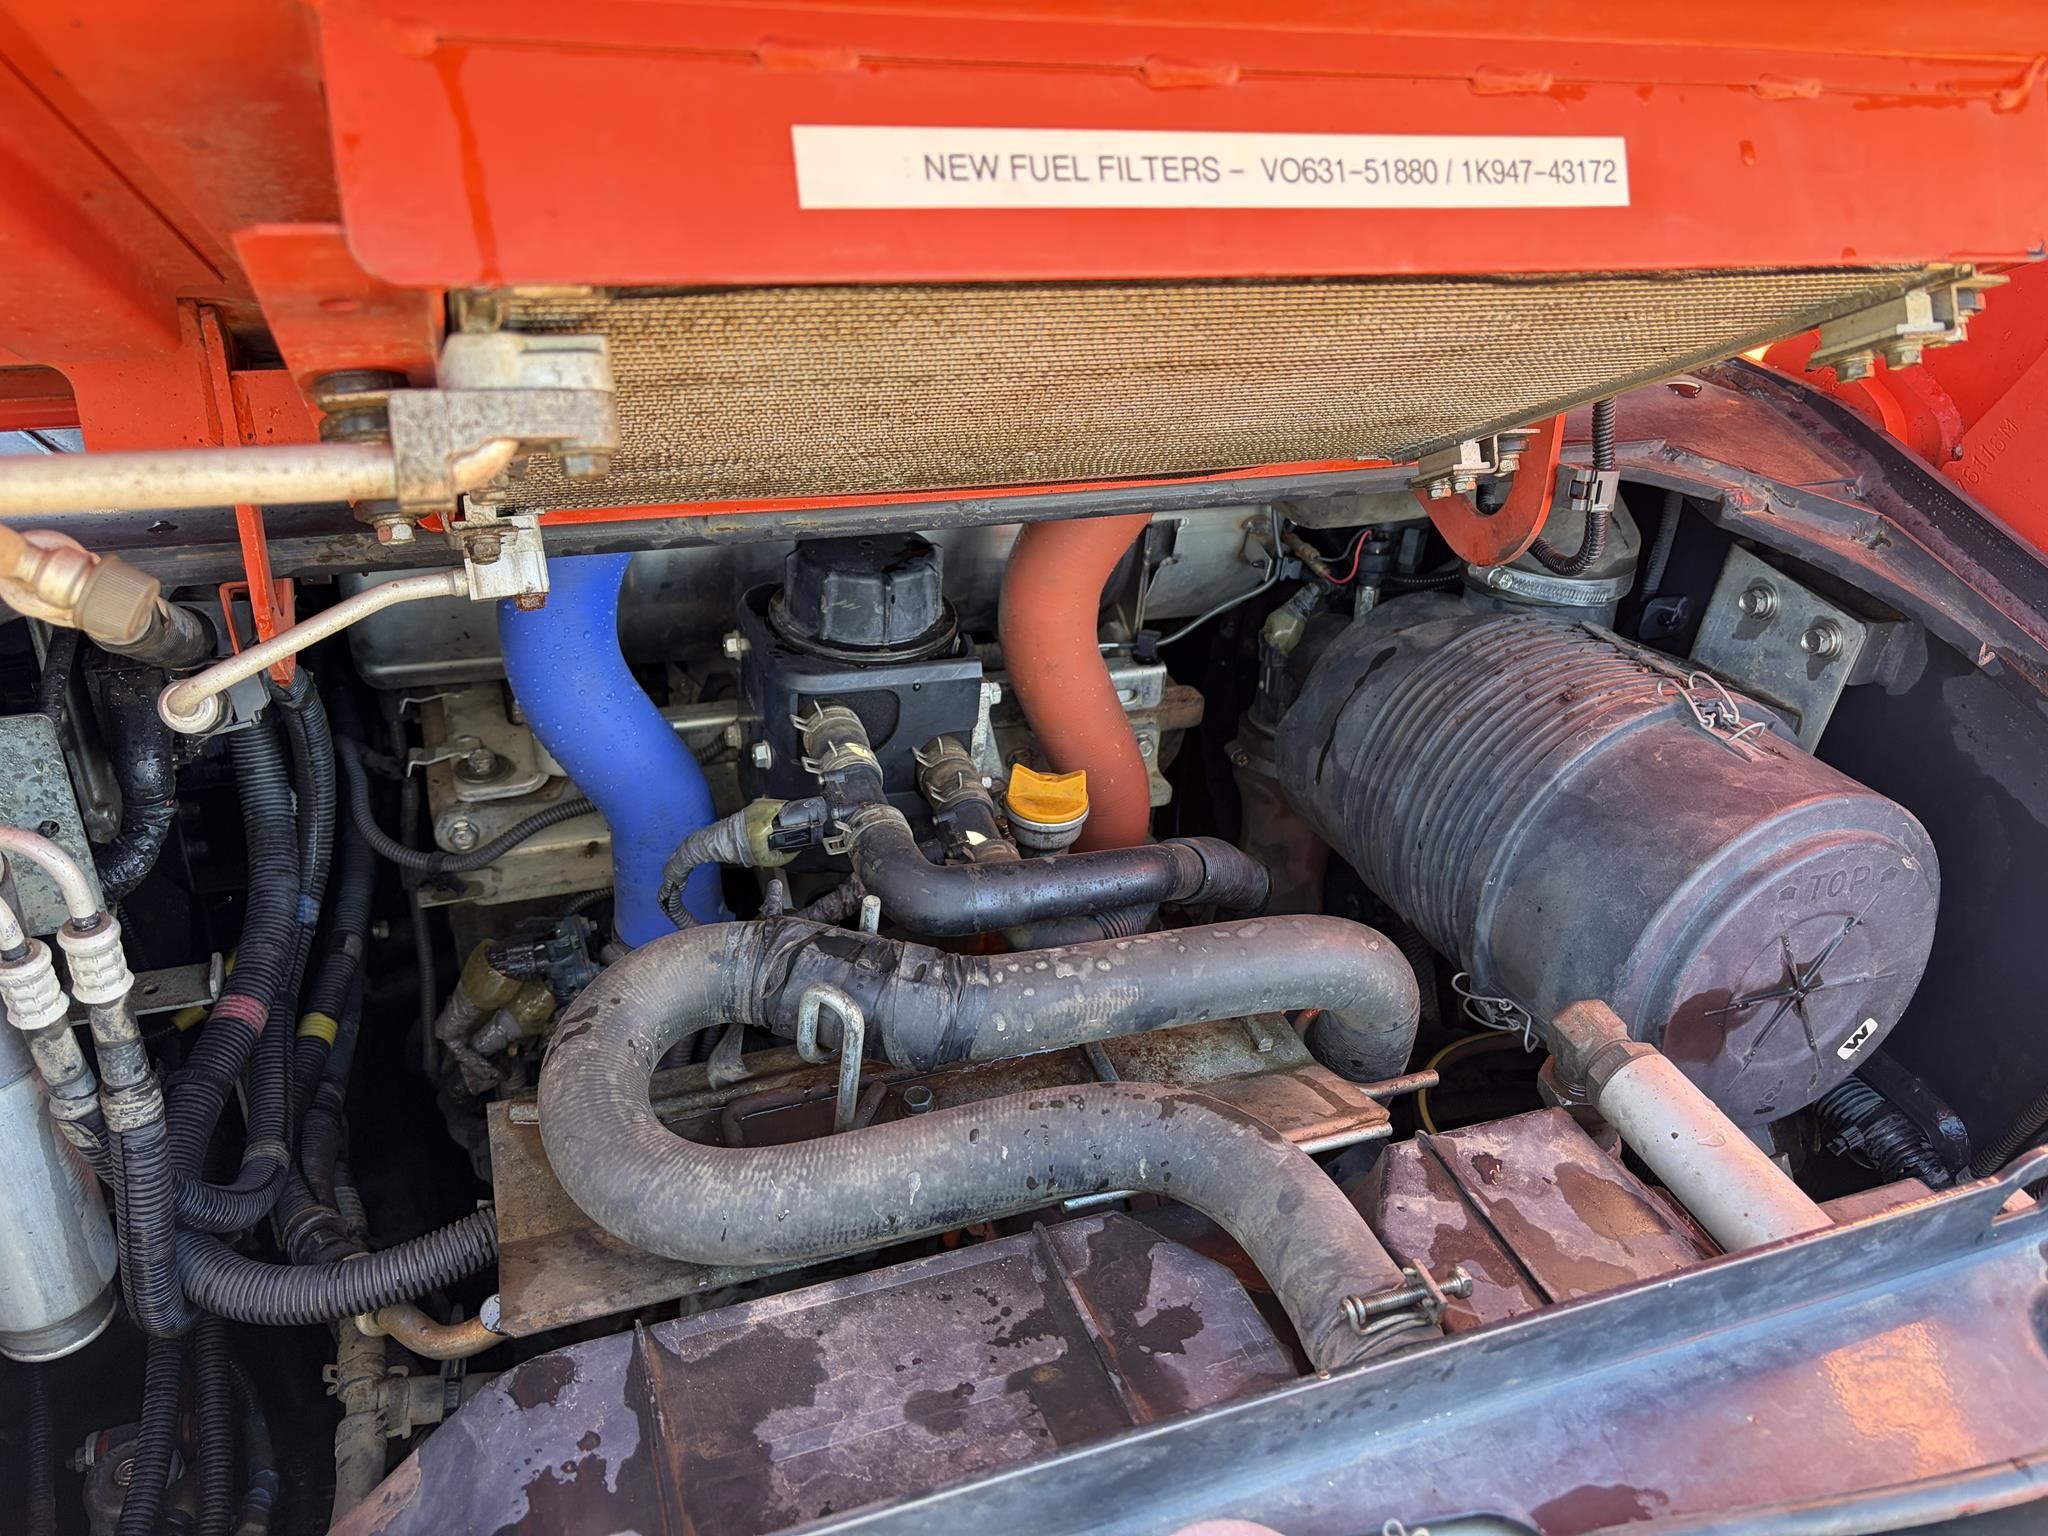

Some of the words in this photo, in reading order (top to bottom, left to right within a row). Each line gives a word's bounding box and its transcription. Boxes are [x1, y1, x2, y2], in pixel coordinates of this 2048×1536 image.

[924, 153, 999, 182] NEW
[1010, 154, 1090, 182] FUEL
[1098, 155, 1221, 184] FILTERS
[1461, 158, 1617, 185] 1K947-43172
[1809, 865, 1871, 901] TOP
